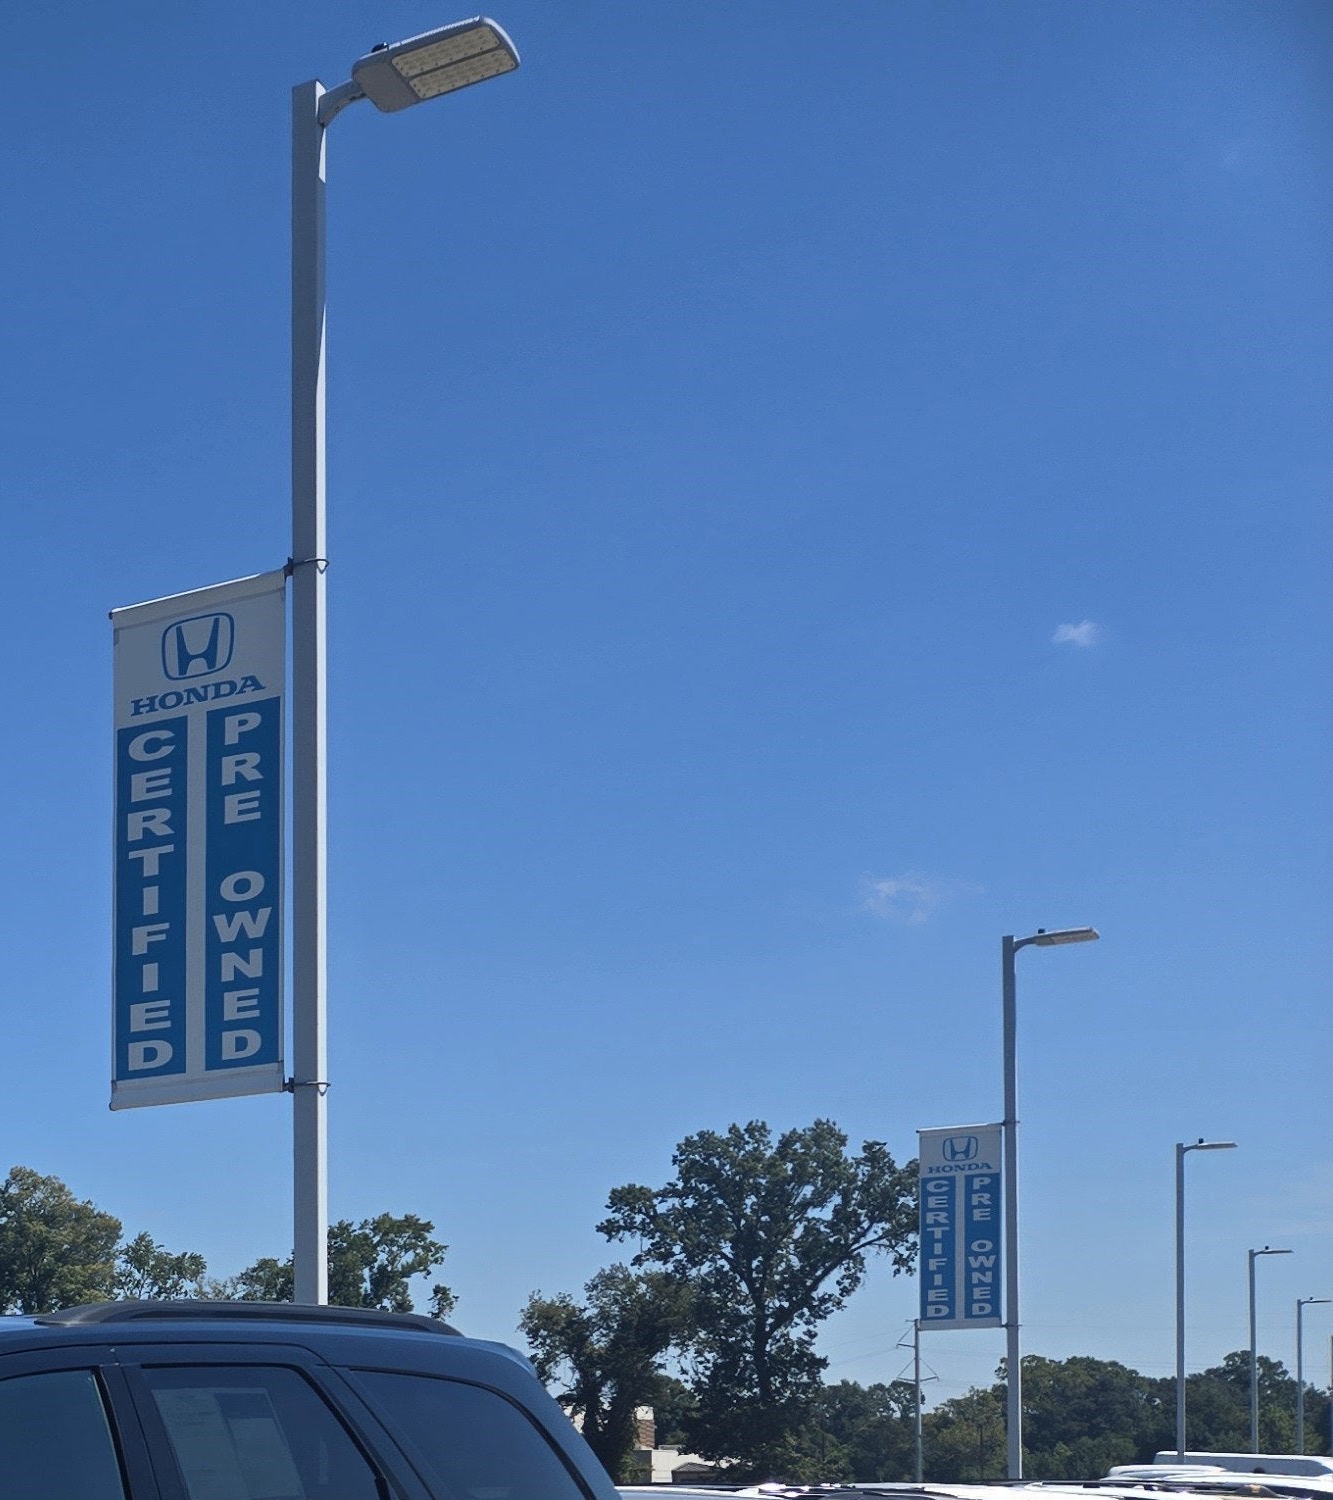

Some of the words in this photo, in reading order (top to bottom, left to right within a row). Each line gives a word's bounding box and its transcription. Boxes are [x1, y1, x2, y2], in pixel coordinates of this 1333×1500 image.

[129, 673, 267, 718] HONDA
[219, 710, 265, 826] PRE
[126, 728, 177, 1072] CERTIFIED
[211, 868, 273, 1062] OWNED
[927, 1162, 993, 1174] HONDA
[970, 1176, 992, 1222] PRE
[925, 1179, 951, 1318] CERTIFIED
[967, 1238, 997, 1317] OWNED
